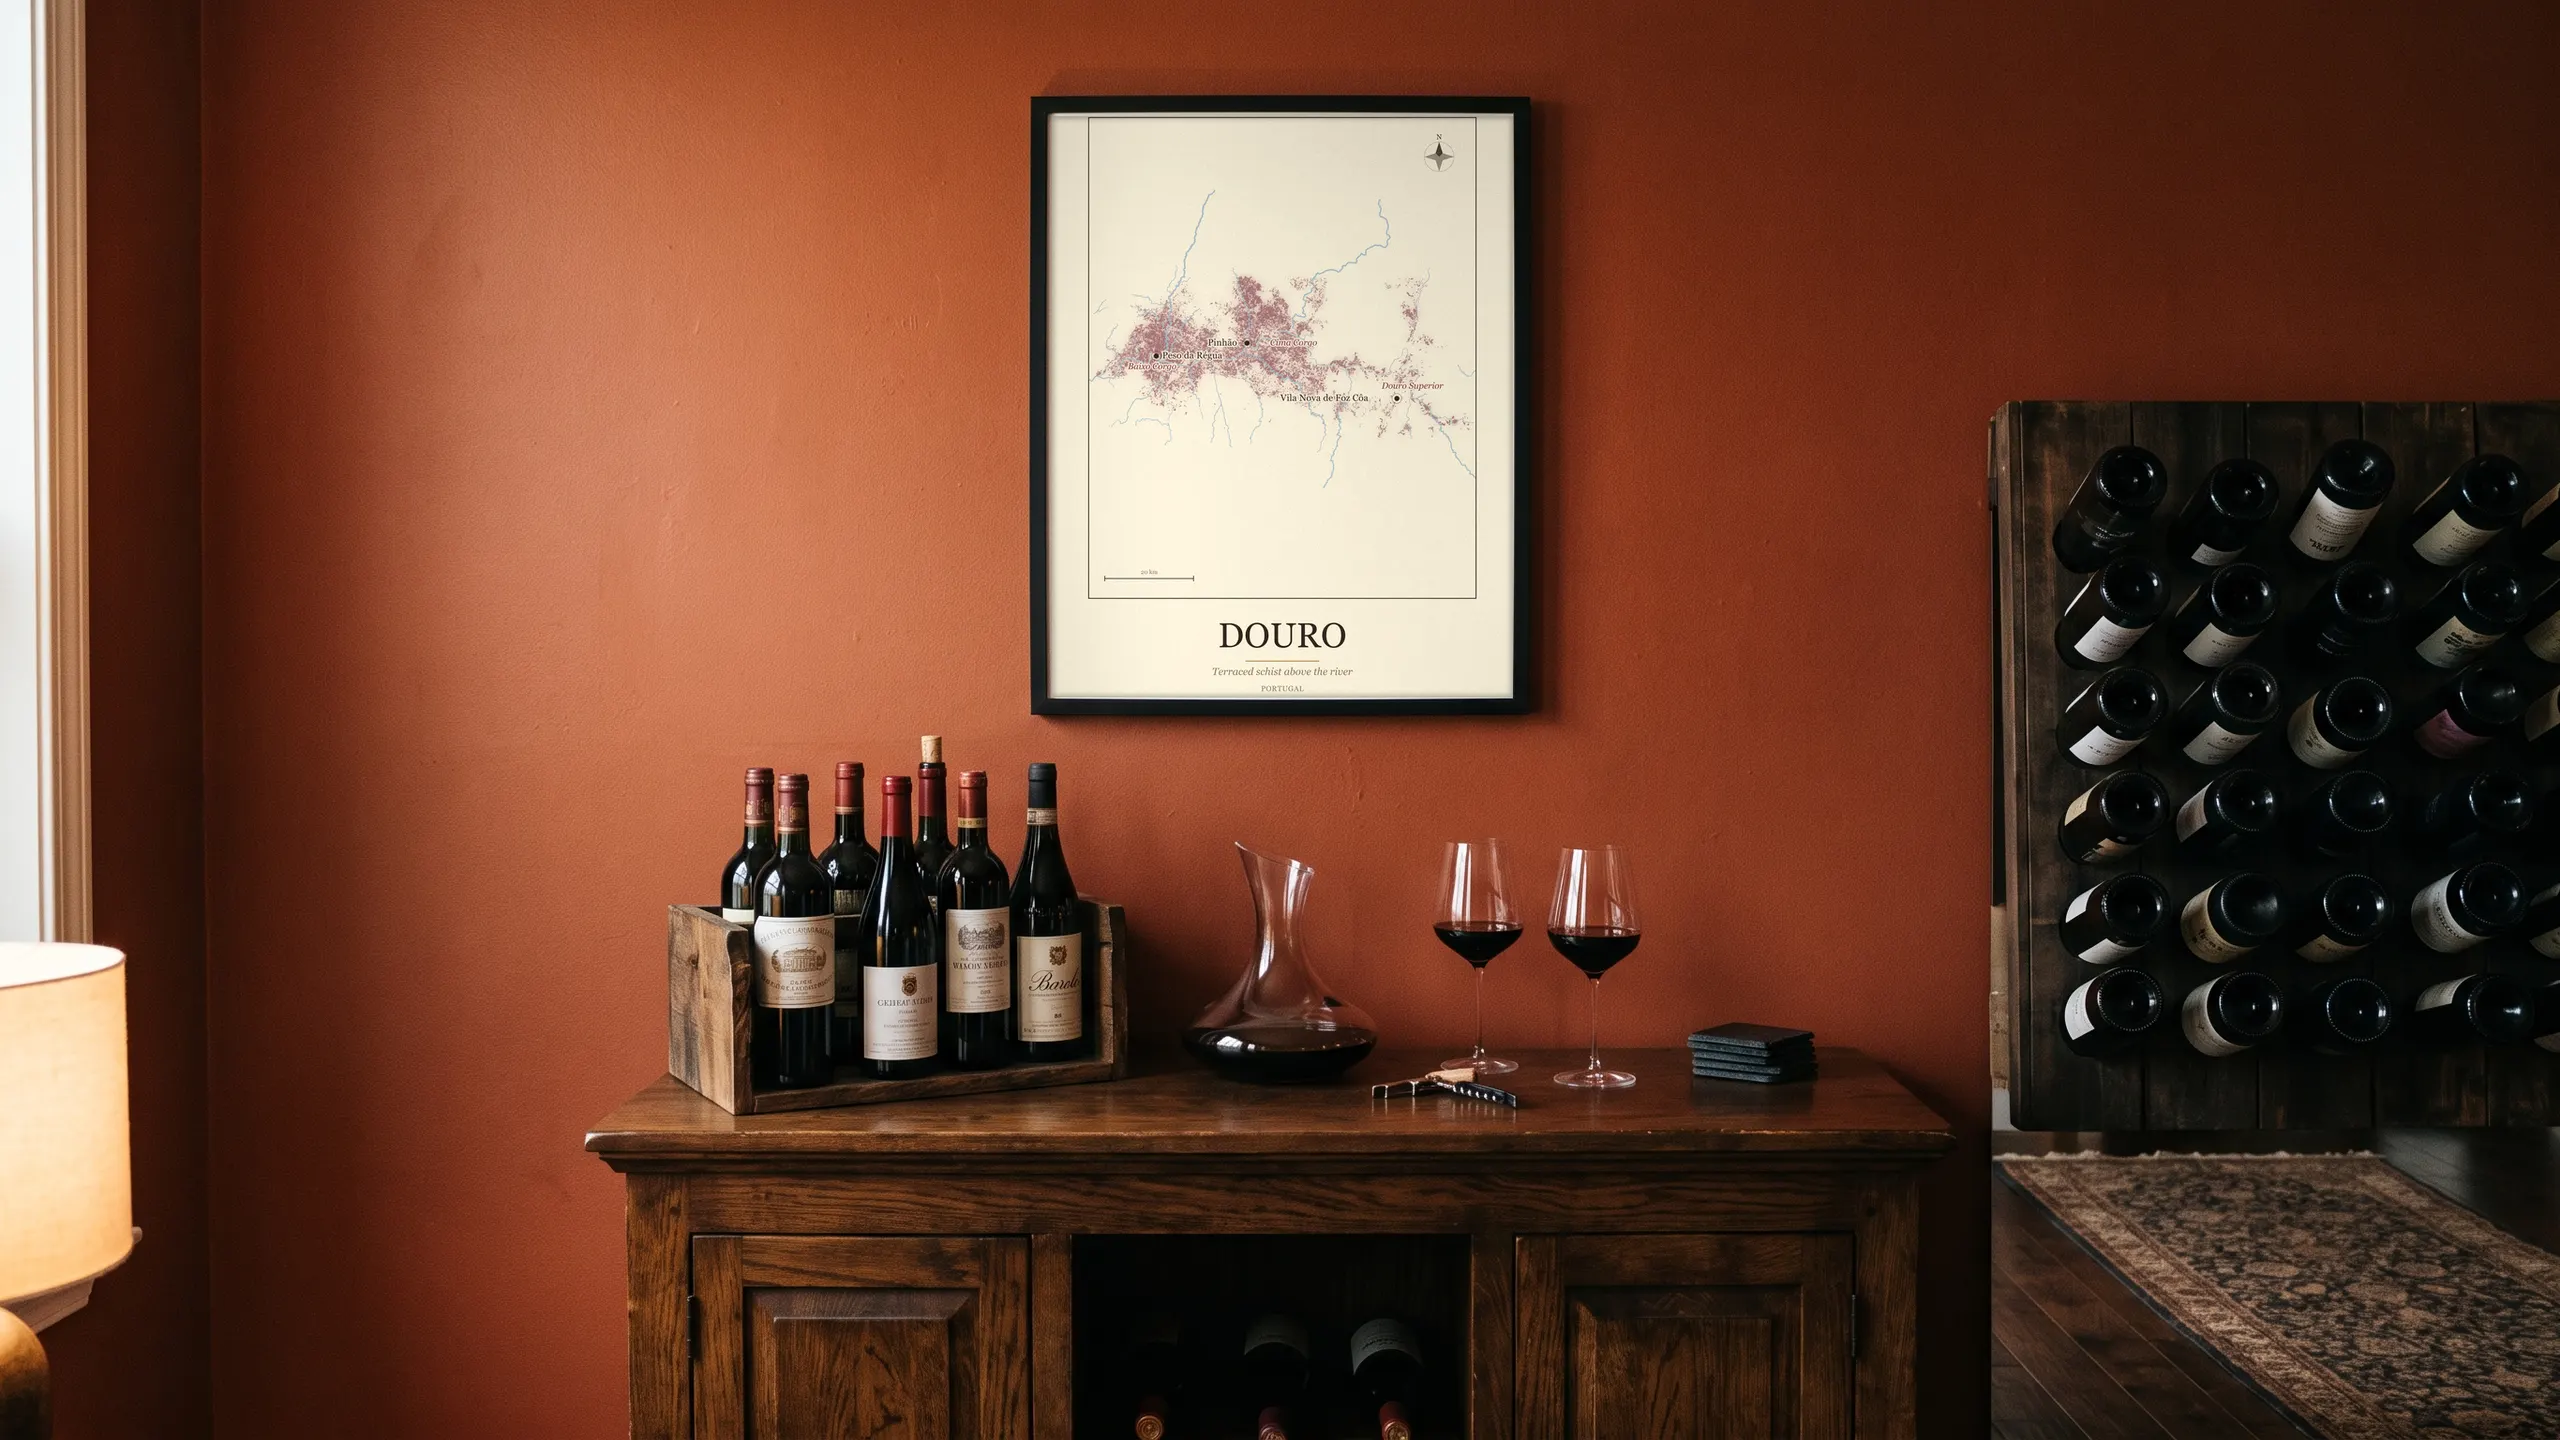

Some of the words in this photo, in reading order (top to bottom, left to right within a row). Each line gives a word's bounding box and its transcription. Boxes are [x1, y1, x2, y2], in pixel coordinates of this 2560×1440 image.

[1208, 338, 1237, 346] Pinhão
[1293, 338, 1318, 348] Corgo
[1198, 351, 1222, 361] Régua
[1152, 362, 1176, 372] Corgo
[1408, 382, 1444, 392] Superior
[1280, 394, 1297, 402] Vila
[1323, 394, 1333, 402] de
[1352, 393, 1368, 402] Côa
[1219, 622, 1346, 648] DOURO
[1212, 667, 1254, 676] Terraced
[1256, 667, 1282, 676] schist
[1284, 667, 1311, 676] above
[1314, 667, 1328, 676] the
[1331, 668, 1353, 676] river
